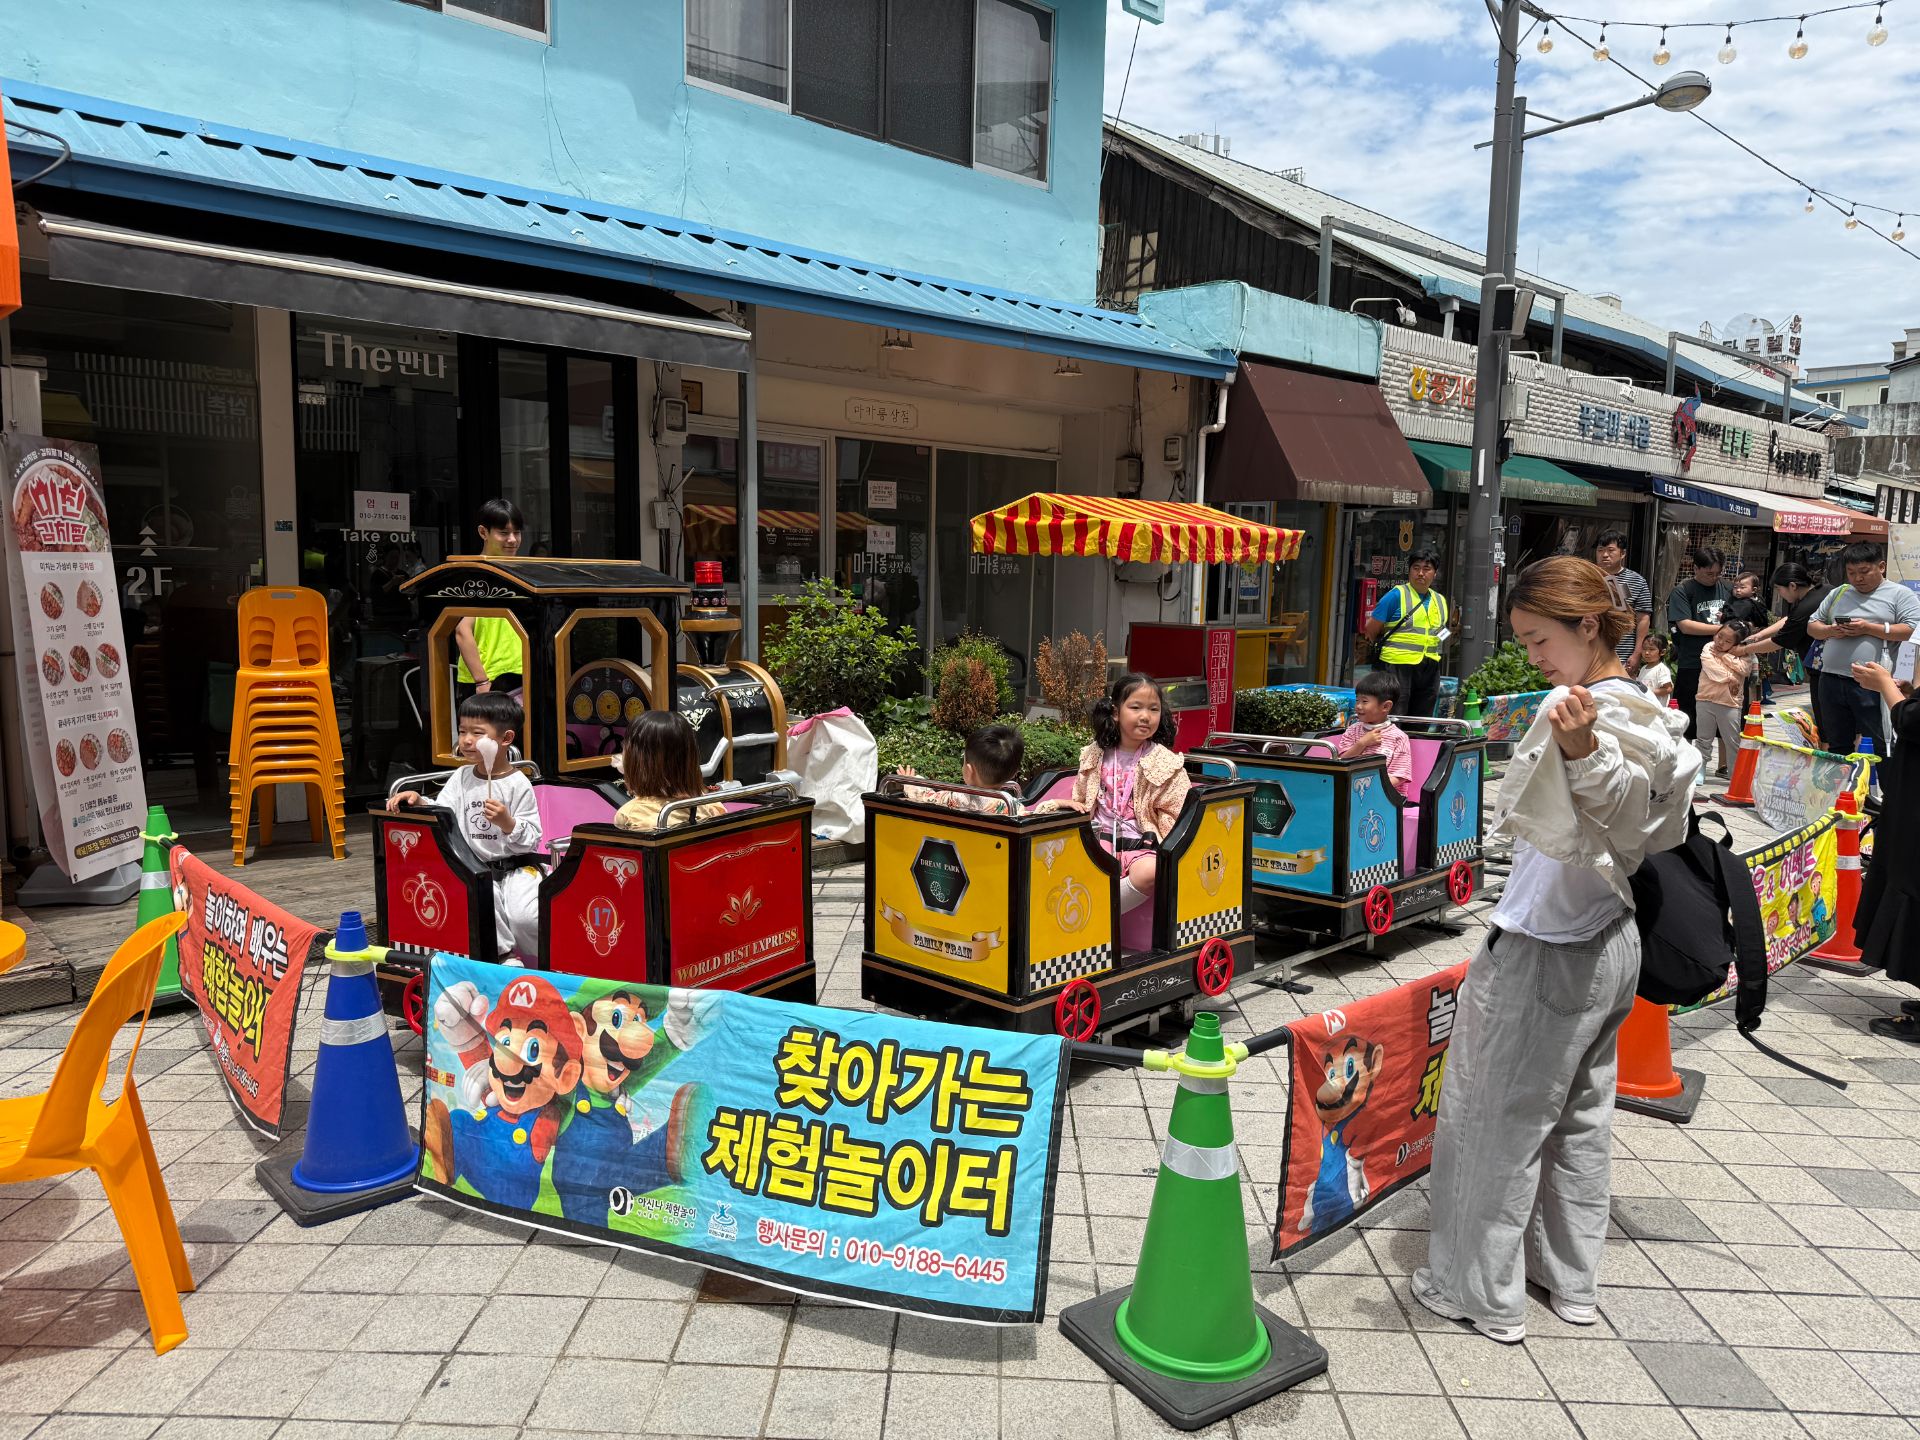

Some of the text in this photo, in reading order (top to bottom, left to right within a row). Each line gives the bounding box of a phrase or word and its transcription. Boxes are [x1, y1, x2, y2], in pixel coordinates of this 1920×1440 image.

[316, 331, 448, 379] The 만나
[1625, 413, 1650, 449] 식품
[29, 473, 86, 519] 미친
[366, 499, 399, 511] 임 대
[33, 518, 89, 545] 김치찜
[339, 528, 417, 543] Take out
[853, 551, 887, 575] 마카롱
[970, 554, 999, 575] 마카롱
[126, 567, 173, 596] 2F
[1270, 798, 1287, 806] PARK
[920, 858, 961, 875] DREAM PARK
[1206, 850, 1220, 873] 15
[1270, 859, 1297, 873] TRAIN
[593, 906, 612, 929] 17
[204, 883, 289, 980] 놀이하며 배우는
[676, 928, 799, 982] WORLD BEST EXPRESS
[913, 933, 974, 960] FAMILY TRAIN
[775, 1028, 1031, 1135] 찾아가는
[704, 1109, 1016, 1234] 체험놀이터
[638, 1196, 664, 1212] 아신나
[665, 1202, 697, 1220] 체험놀이
[757, 1220, 825, 1256] 행사문의
[845, 1239, 1007, 1283] 010-9188-6445
